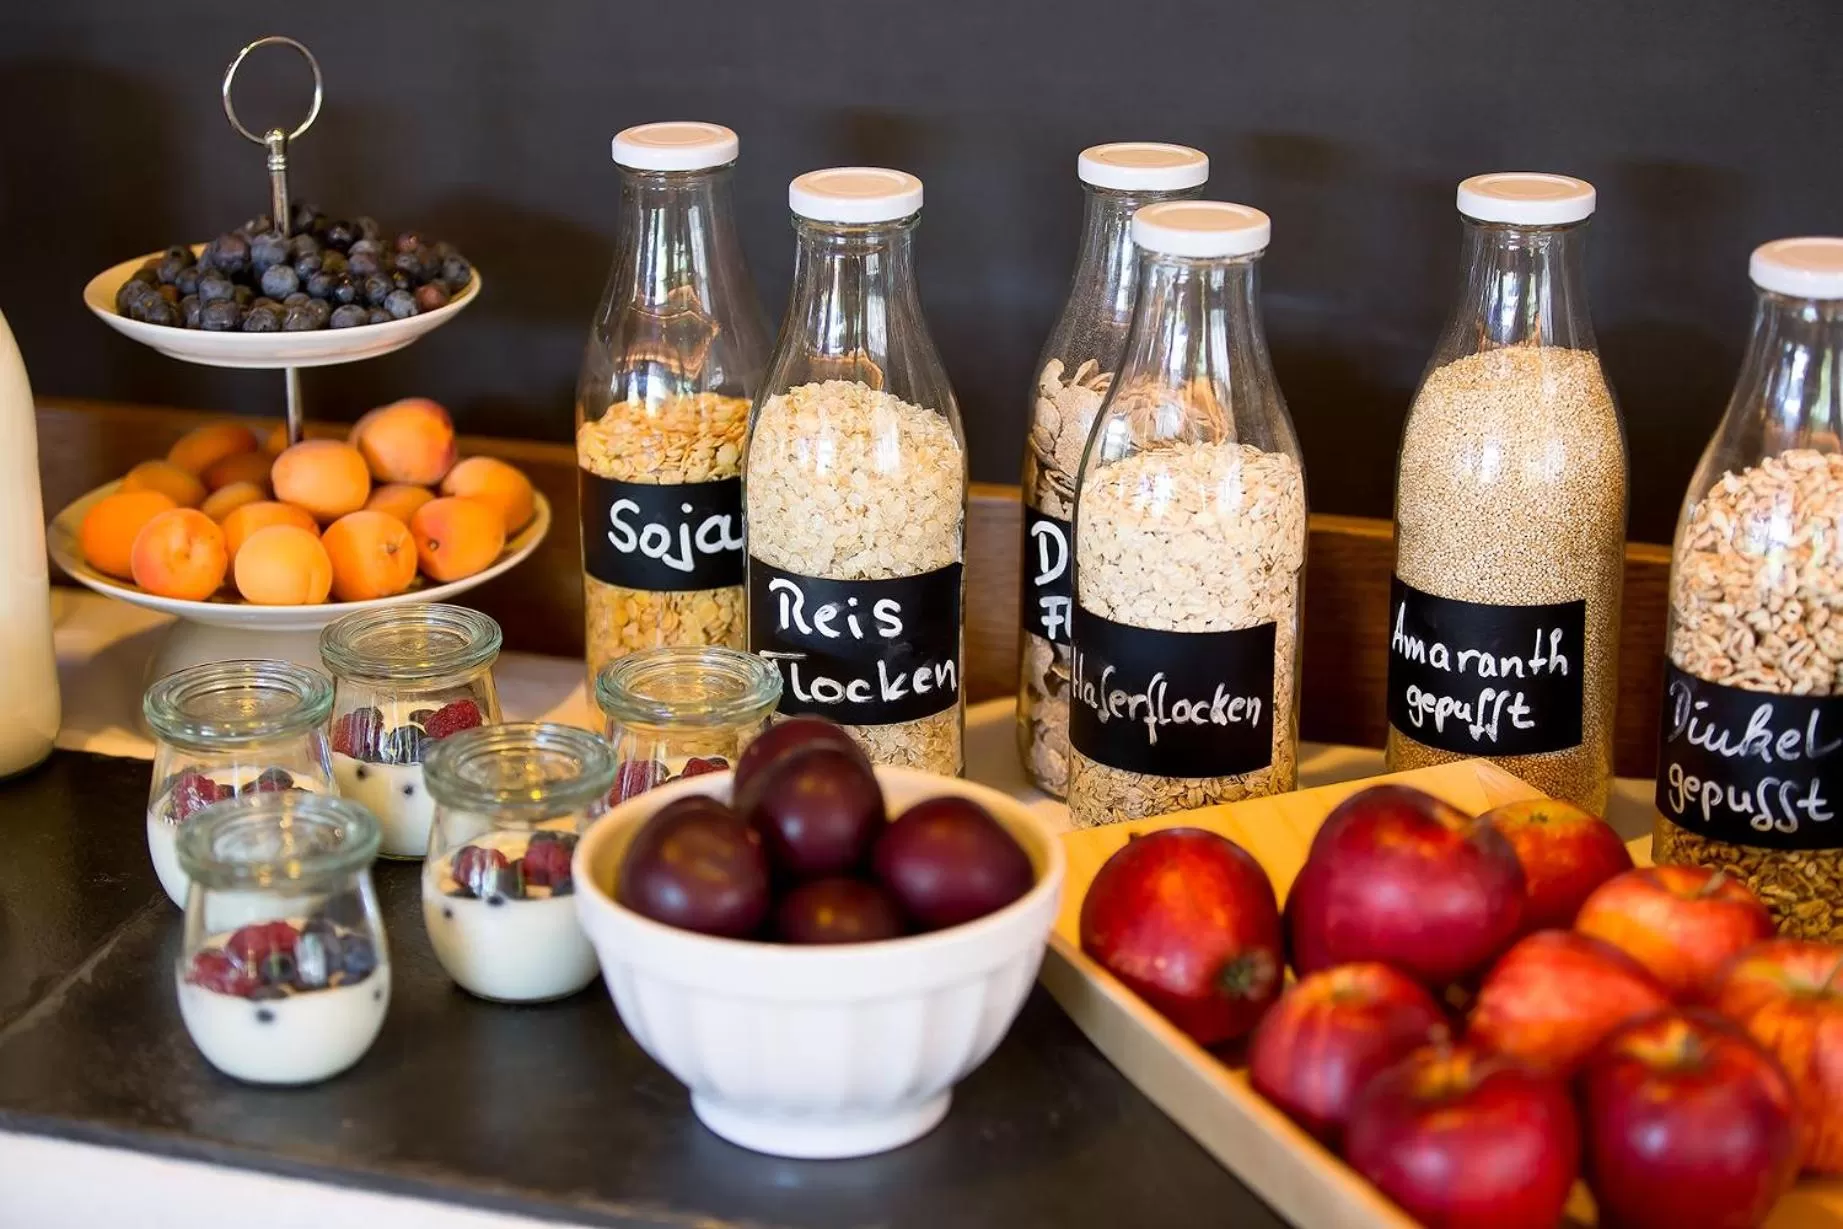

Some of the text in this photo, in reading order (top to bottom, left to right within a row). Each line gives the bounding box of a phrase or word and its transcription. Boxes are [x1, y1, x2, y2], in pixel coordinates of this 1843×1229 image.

[608, 499, 743, 572] Soja
[768, 577, 904, 639] Reis
[1392, 601, 1568, 678] Amaranth
[1073, 646, 1262, 746] Haferflocken
[1406, 684, 1536, 743] gepufft
[1668, 680, 1843, 764] Dinkel
[1668, 762, 1835, 834] gepufft
